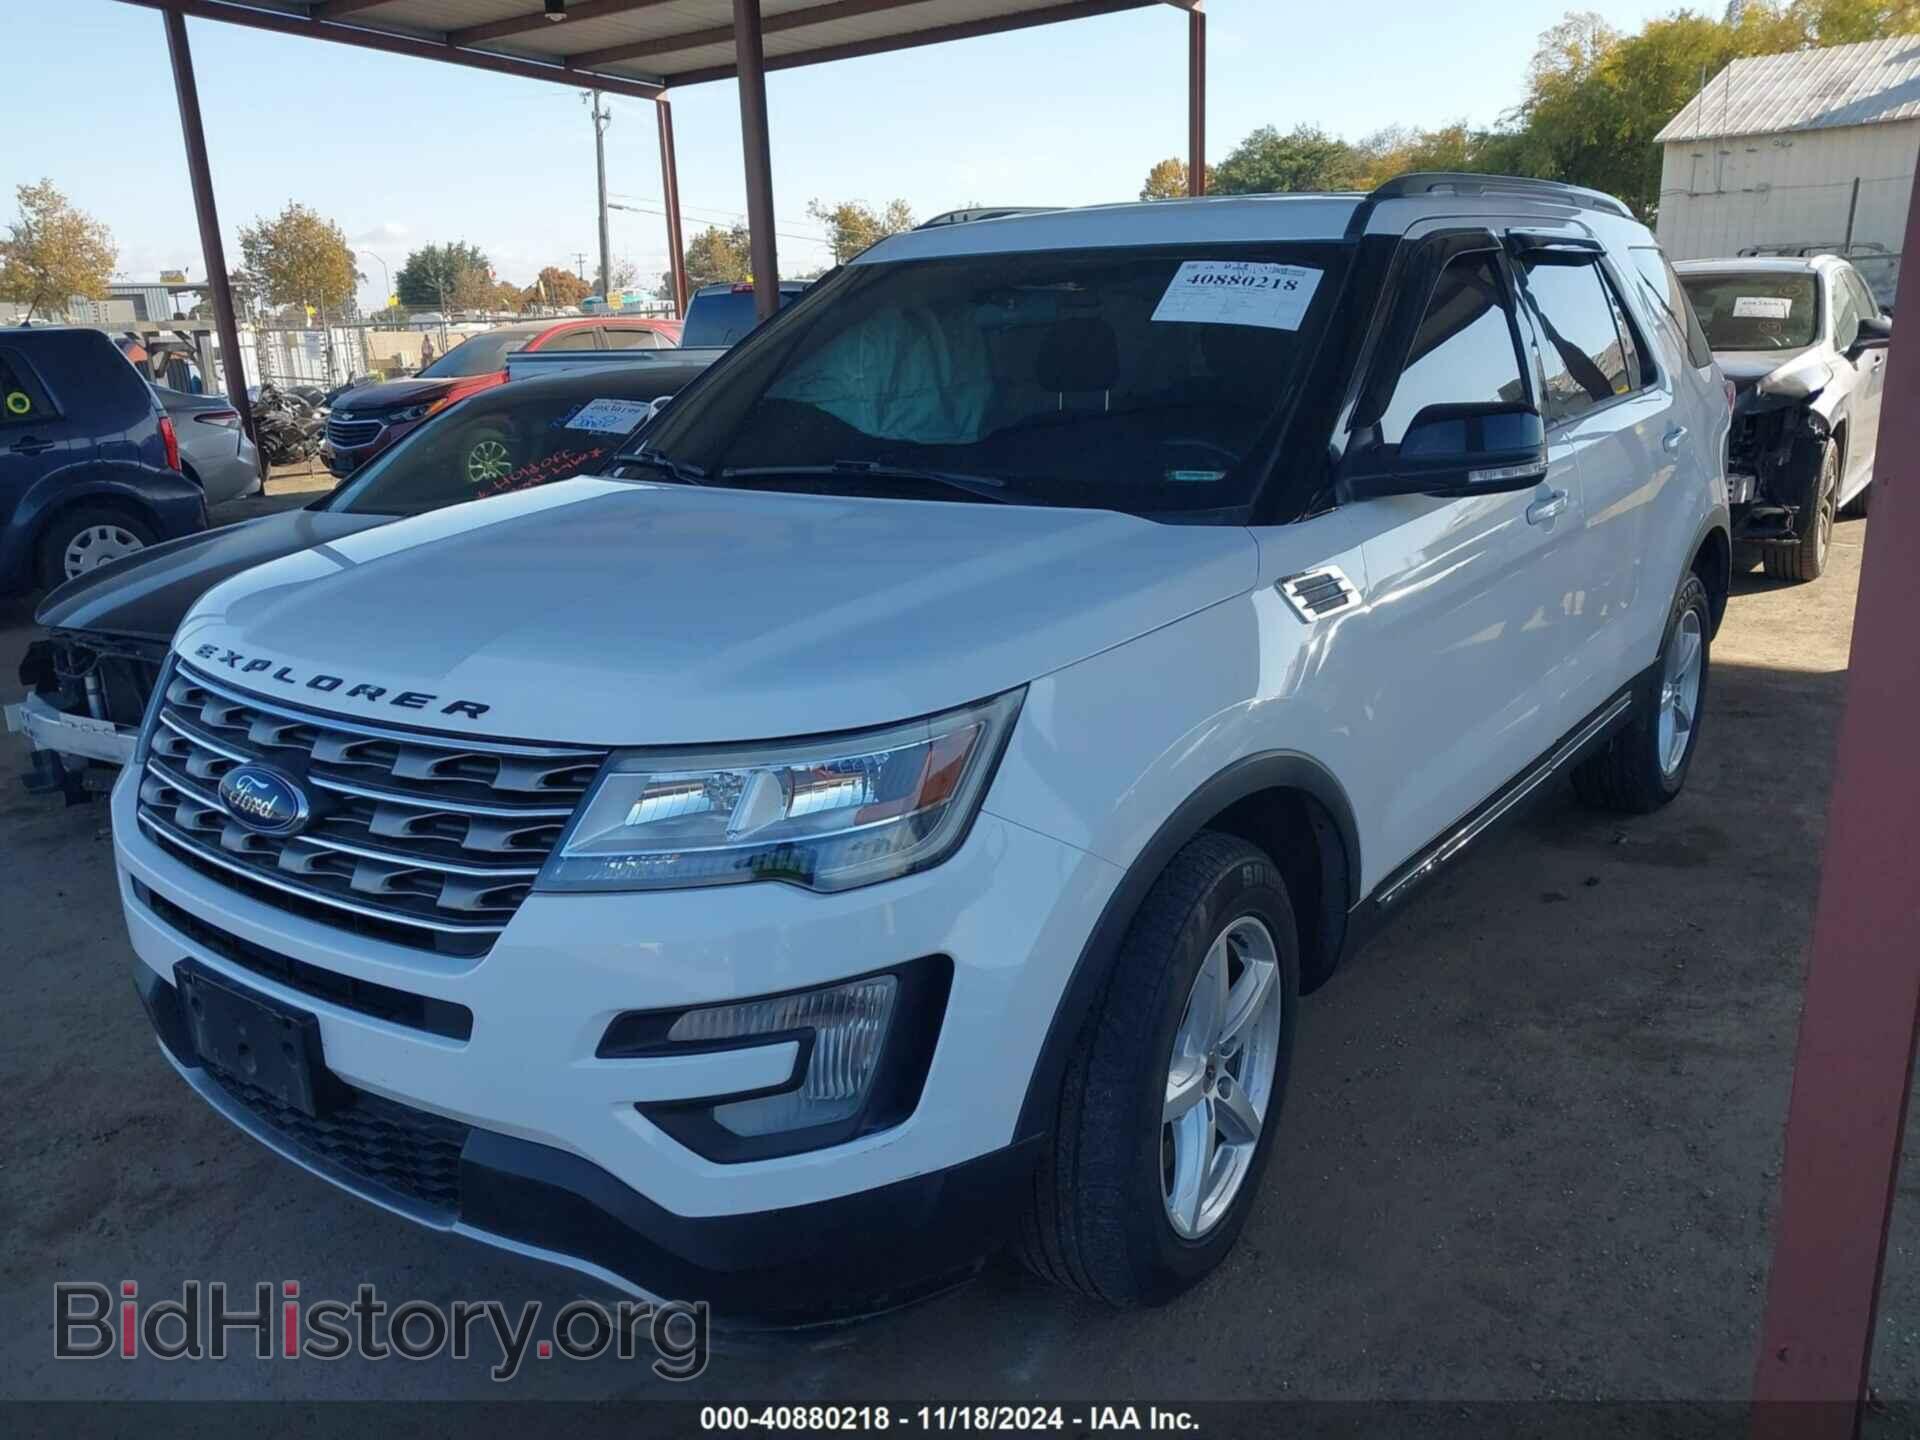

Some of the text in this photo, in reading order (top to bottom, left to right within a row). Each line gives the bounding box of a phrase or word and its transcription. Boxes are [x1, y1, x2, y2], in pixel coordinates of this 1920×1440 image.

[1187, 273, 1299, 291] 40880218
[195, 643, 491, 720] EXPLORER
[228, 774, 279, 819] Ford
